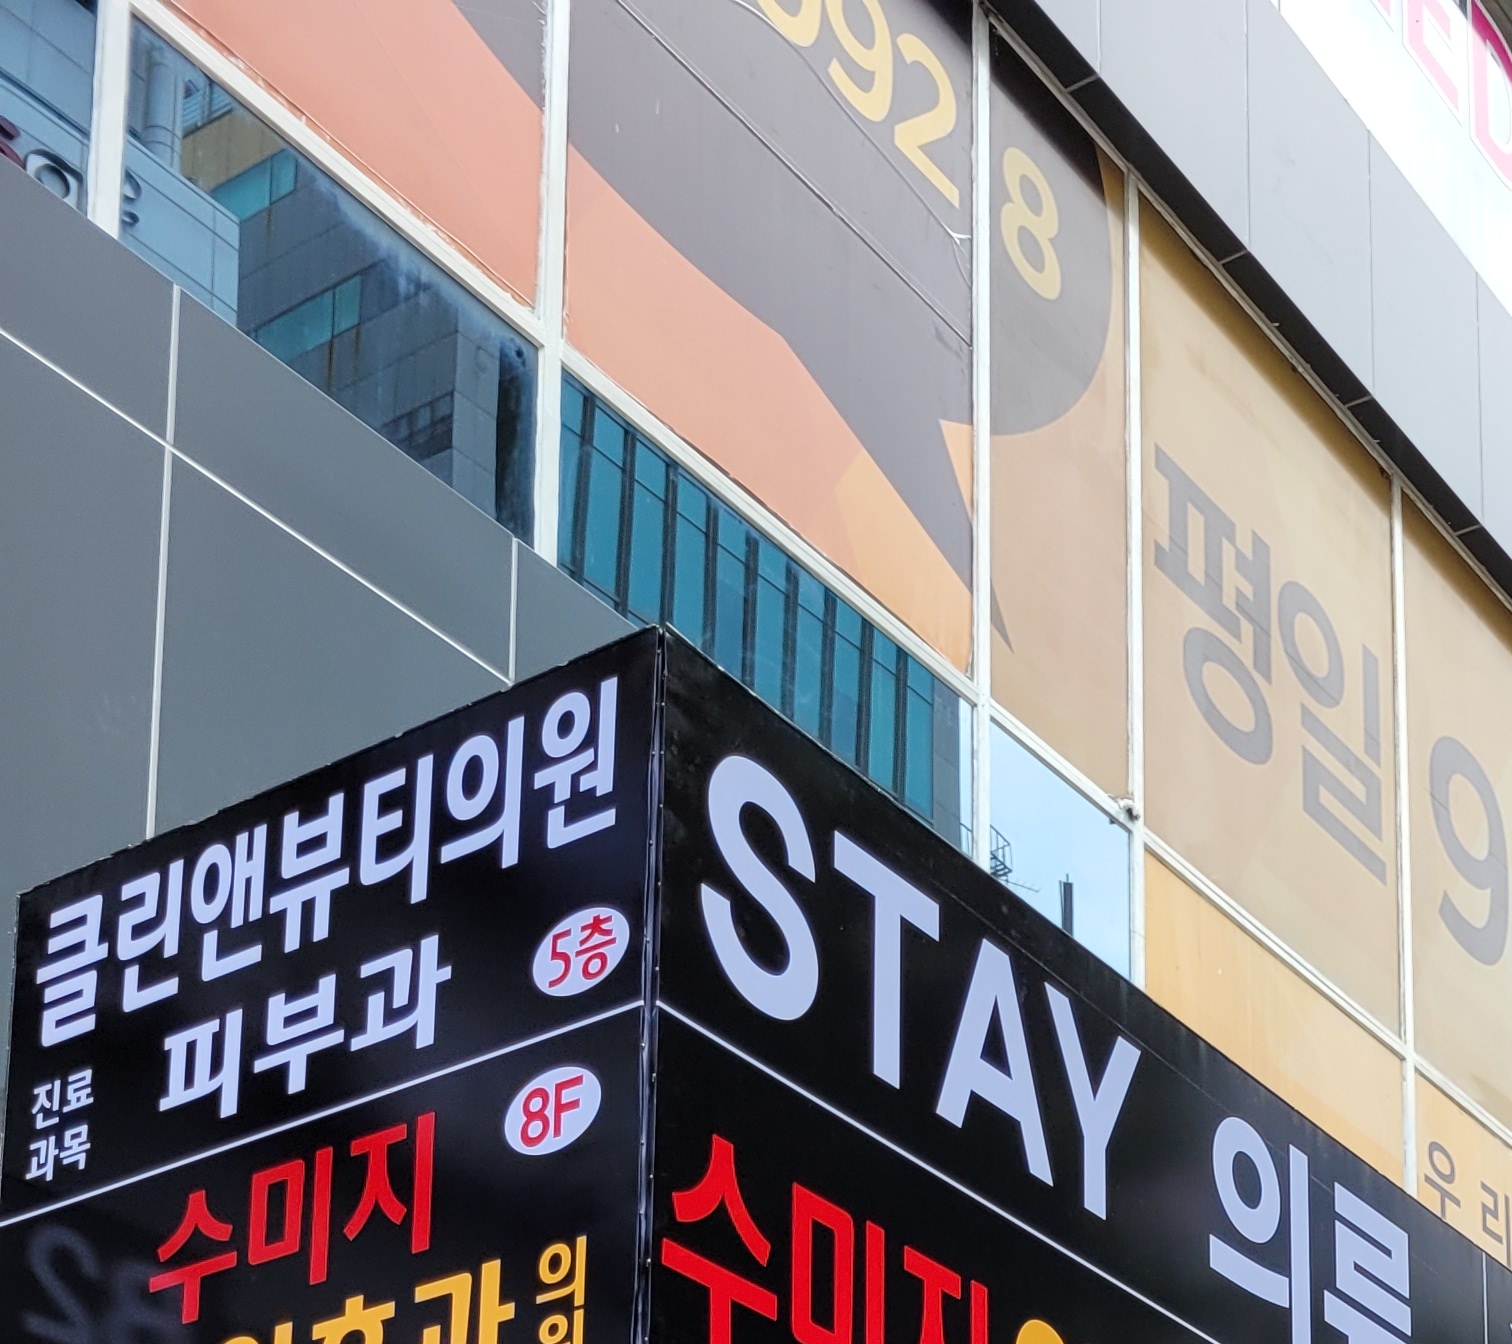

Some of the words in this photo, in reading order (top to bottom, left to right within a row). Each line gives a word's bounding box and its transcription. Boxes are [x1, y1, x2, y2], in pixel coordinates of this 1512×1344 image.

[1153, 443, 1388, 886] 평일
[35, 676, 619, 1048] 클린앤뷰티의원
[545, 914, 617, 988] 5층
[159, 936, 453, 1119] 피부과
[700, 755, 1142, 1221] STAY
[26, 1125, 91, 1182] 과목
[31, 1066, 95, 1131] 진료
[520, 1074, 584, 1151] 8F
[148, 1112, 434, 1324] 수미지
